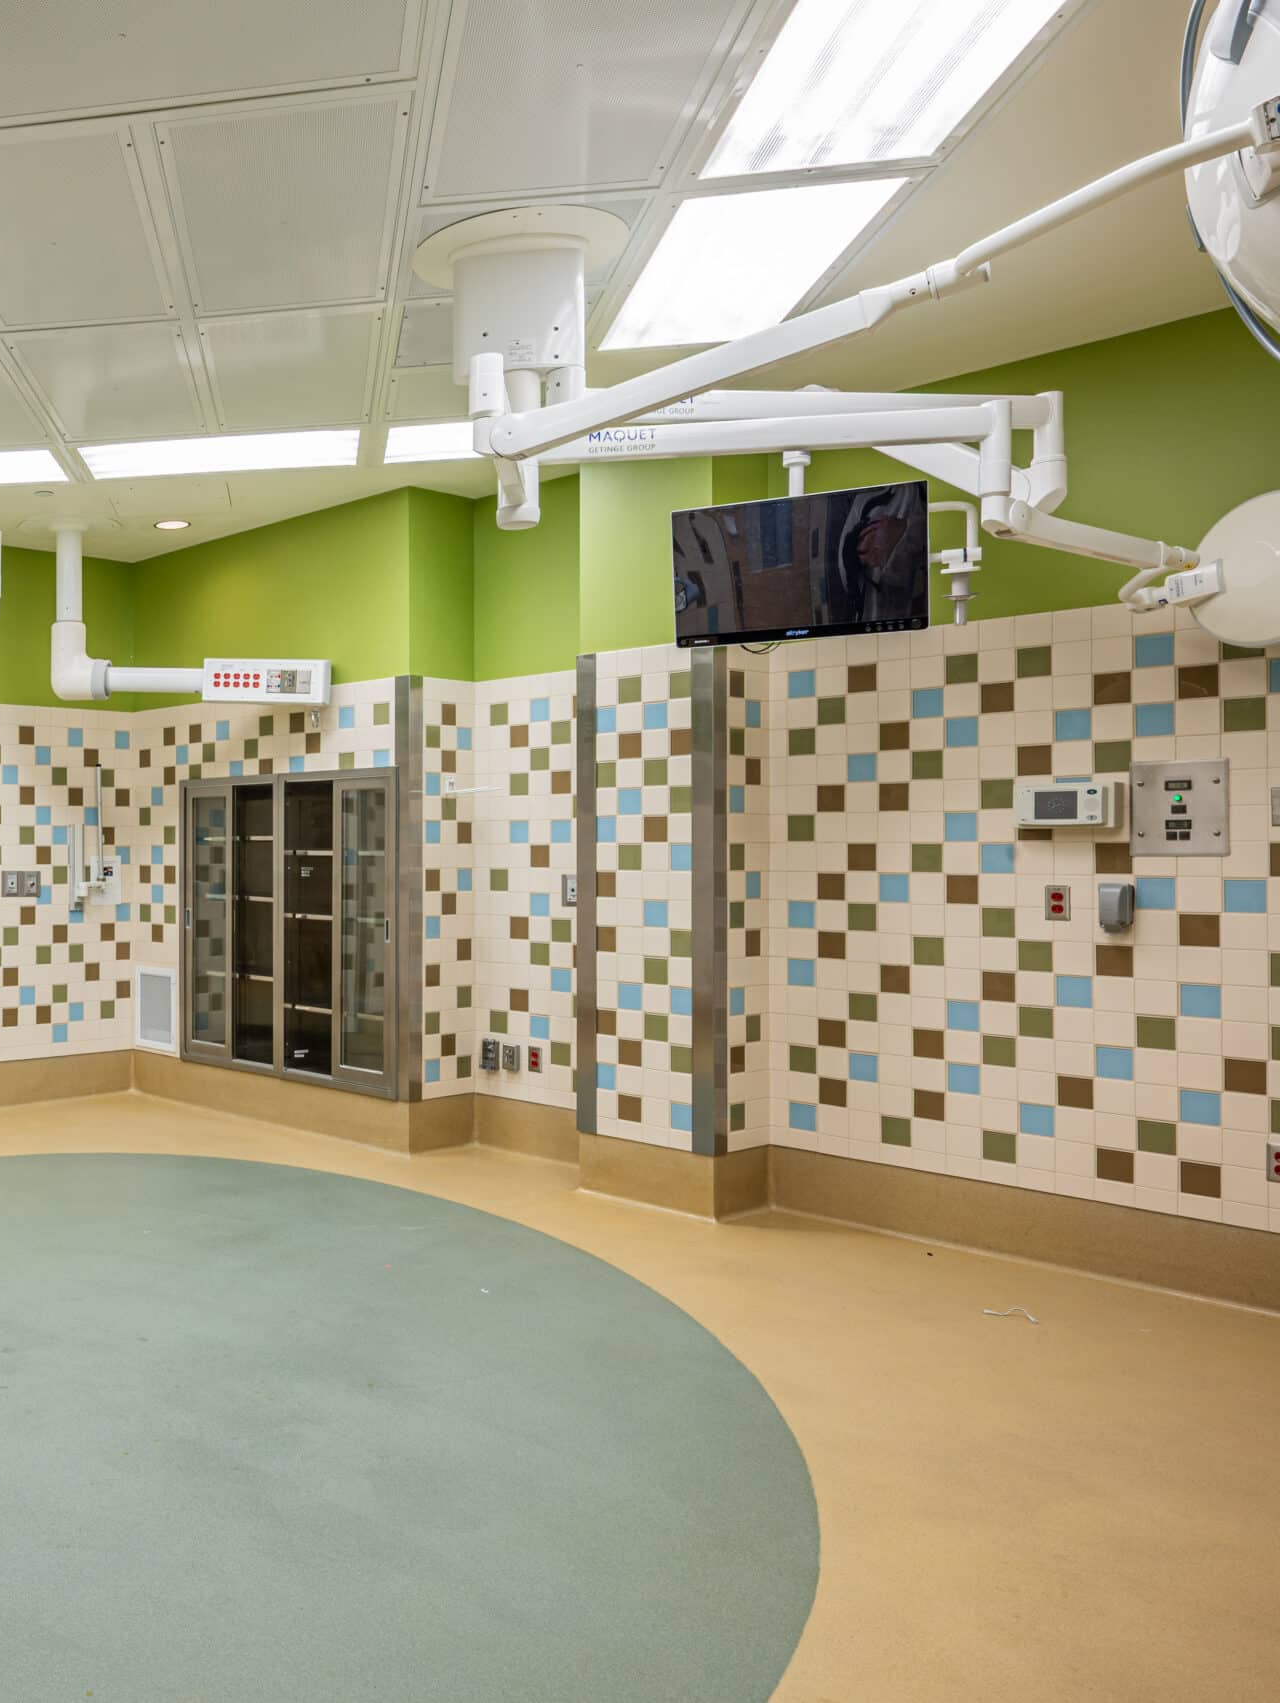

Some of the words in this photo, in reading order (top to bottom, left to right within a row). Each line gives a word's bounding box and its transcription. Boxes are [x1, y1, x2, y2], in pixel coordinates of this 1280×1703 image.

[588, 428, 656, 442] MAQUET
[588, 445, 623, 454] GETINGE
[627, 443, 656, 452] GROUP
